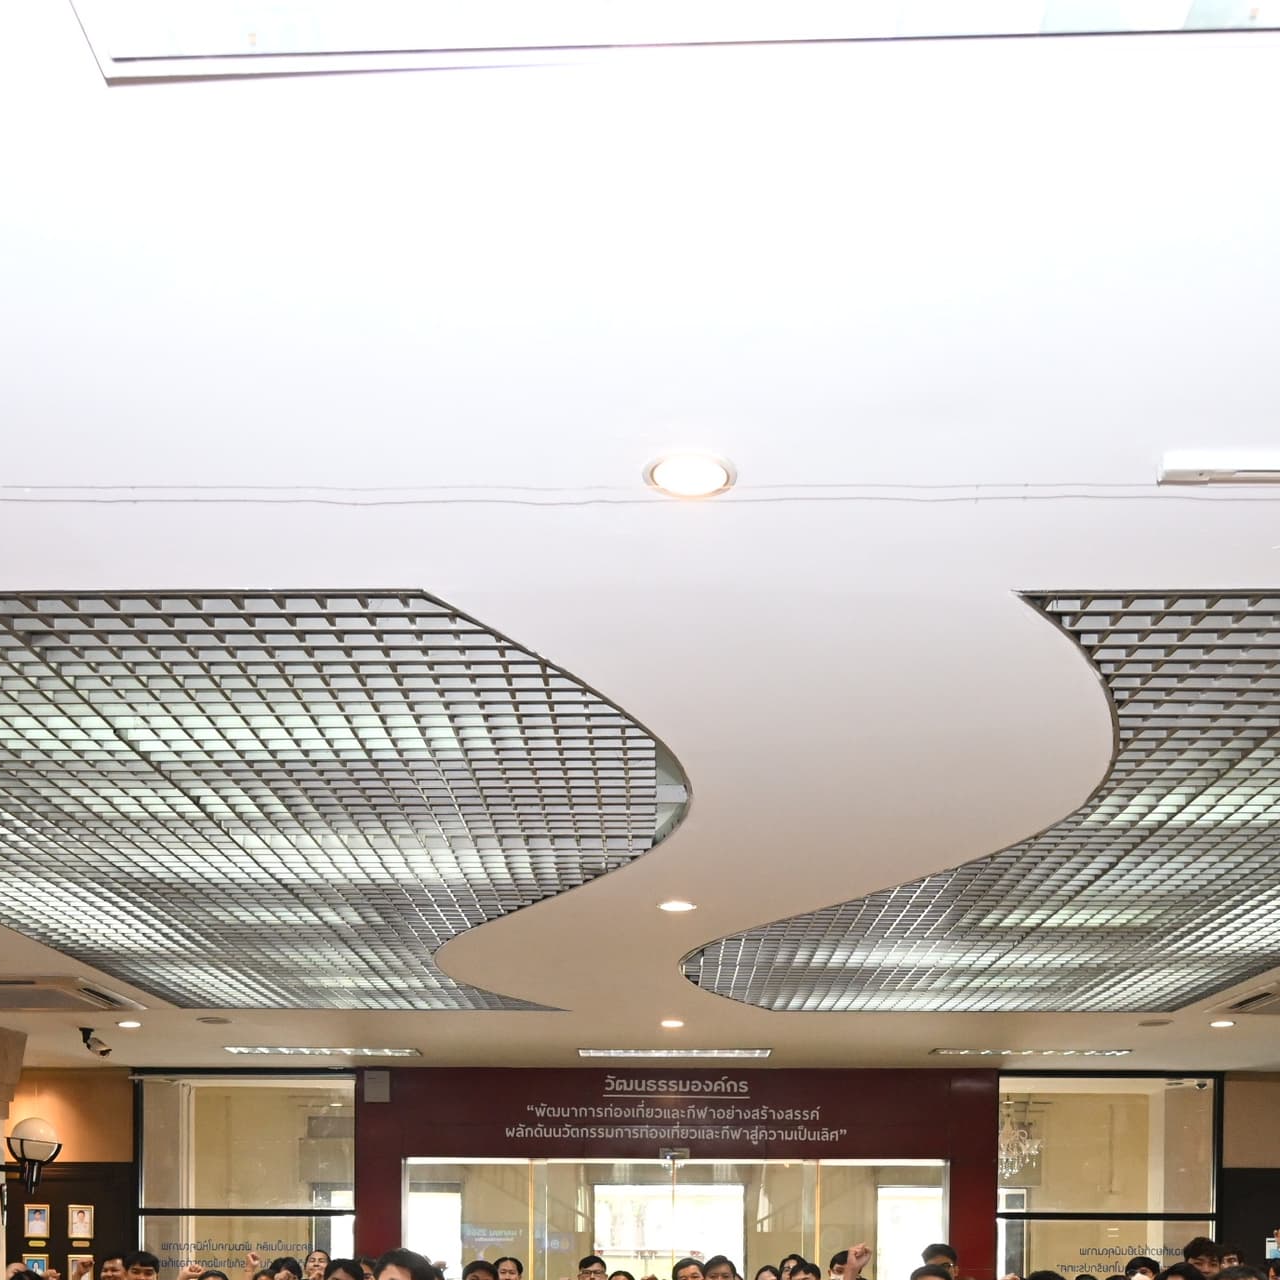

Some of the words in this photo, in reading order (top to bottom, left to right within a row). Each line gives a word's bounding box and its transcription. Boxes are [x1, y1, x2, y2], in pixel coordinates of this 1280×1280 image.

[604, 1076, 749, 1094] วัฒนธรรมองค์กร
[526, 1101, 821, 1122] “พัฒนาการท่องเที่ยวและกีฬาอย่างสร้างสรรค์
